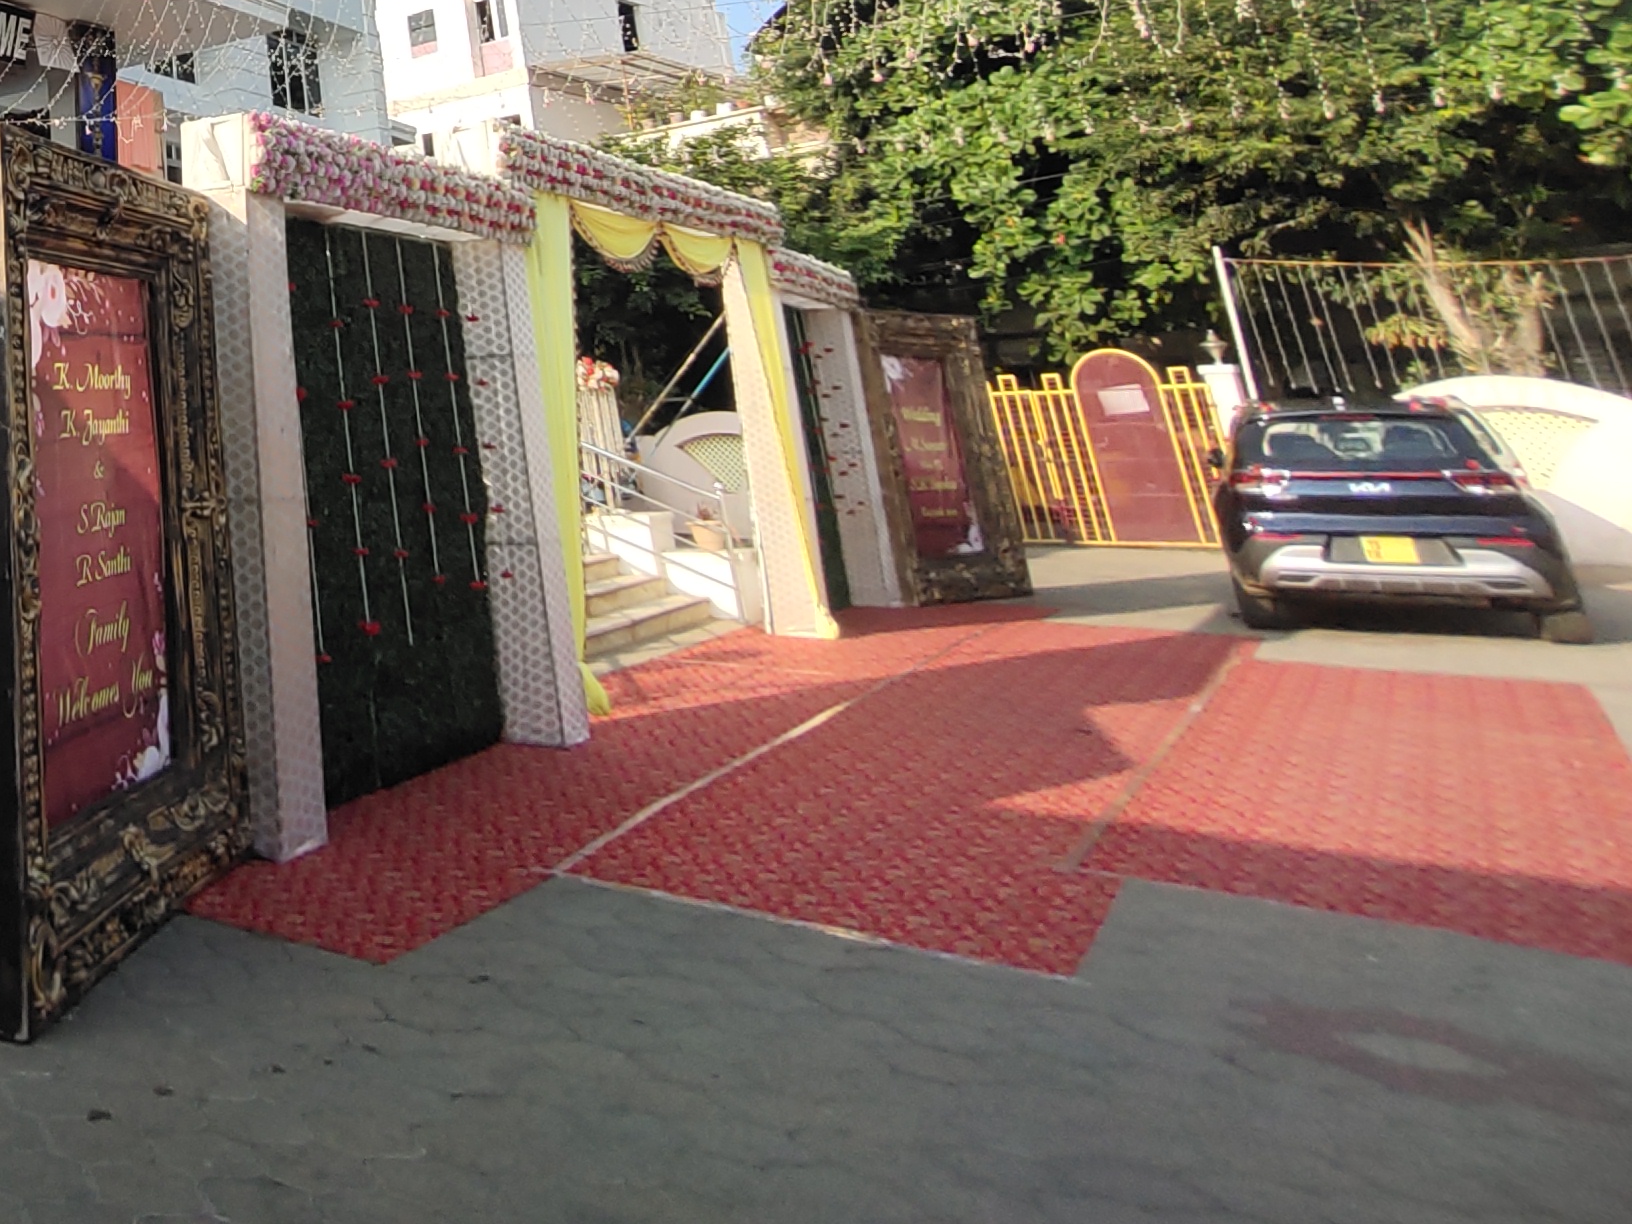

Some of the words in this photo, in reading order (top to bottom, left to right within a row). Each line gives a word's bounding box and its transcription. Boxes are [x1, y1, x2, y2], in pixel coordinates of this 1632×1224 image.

[52, 362, 73, 391] K.
[76, 363, 131, 399] Moorthy
[59, 409, 80, 439] K.
[82, 408, 130, 446] Jayanthi
[93, 460, 104, 479] &
[90, 502, 126, 538] Rajan
[95, 545, 131, 580] Santhi
[74, 599, 130, 658] Family
[123, 652, 153, 718] You
